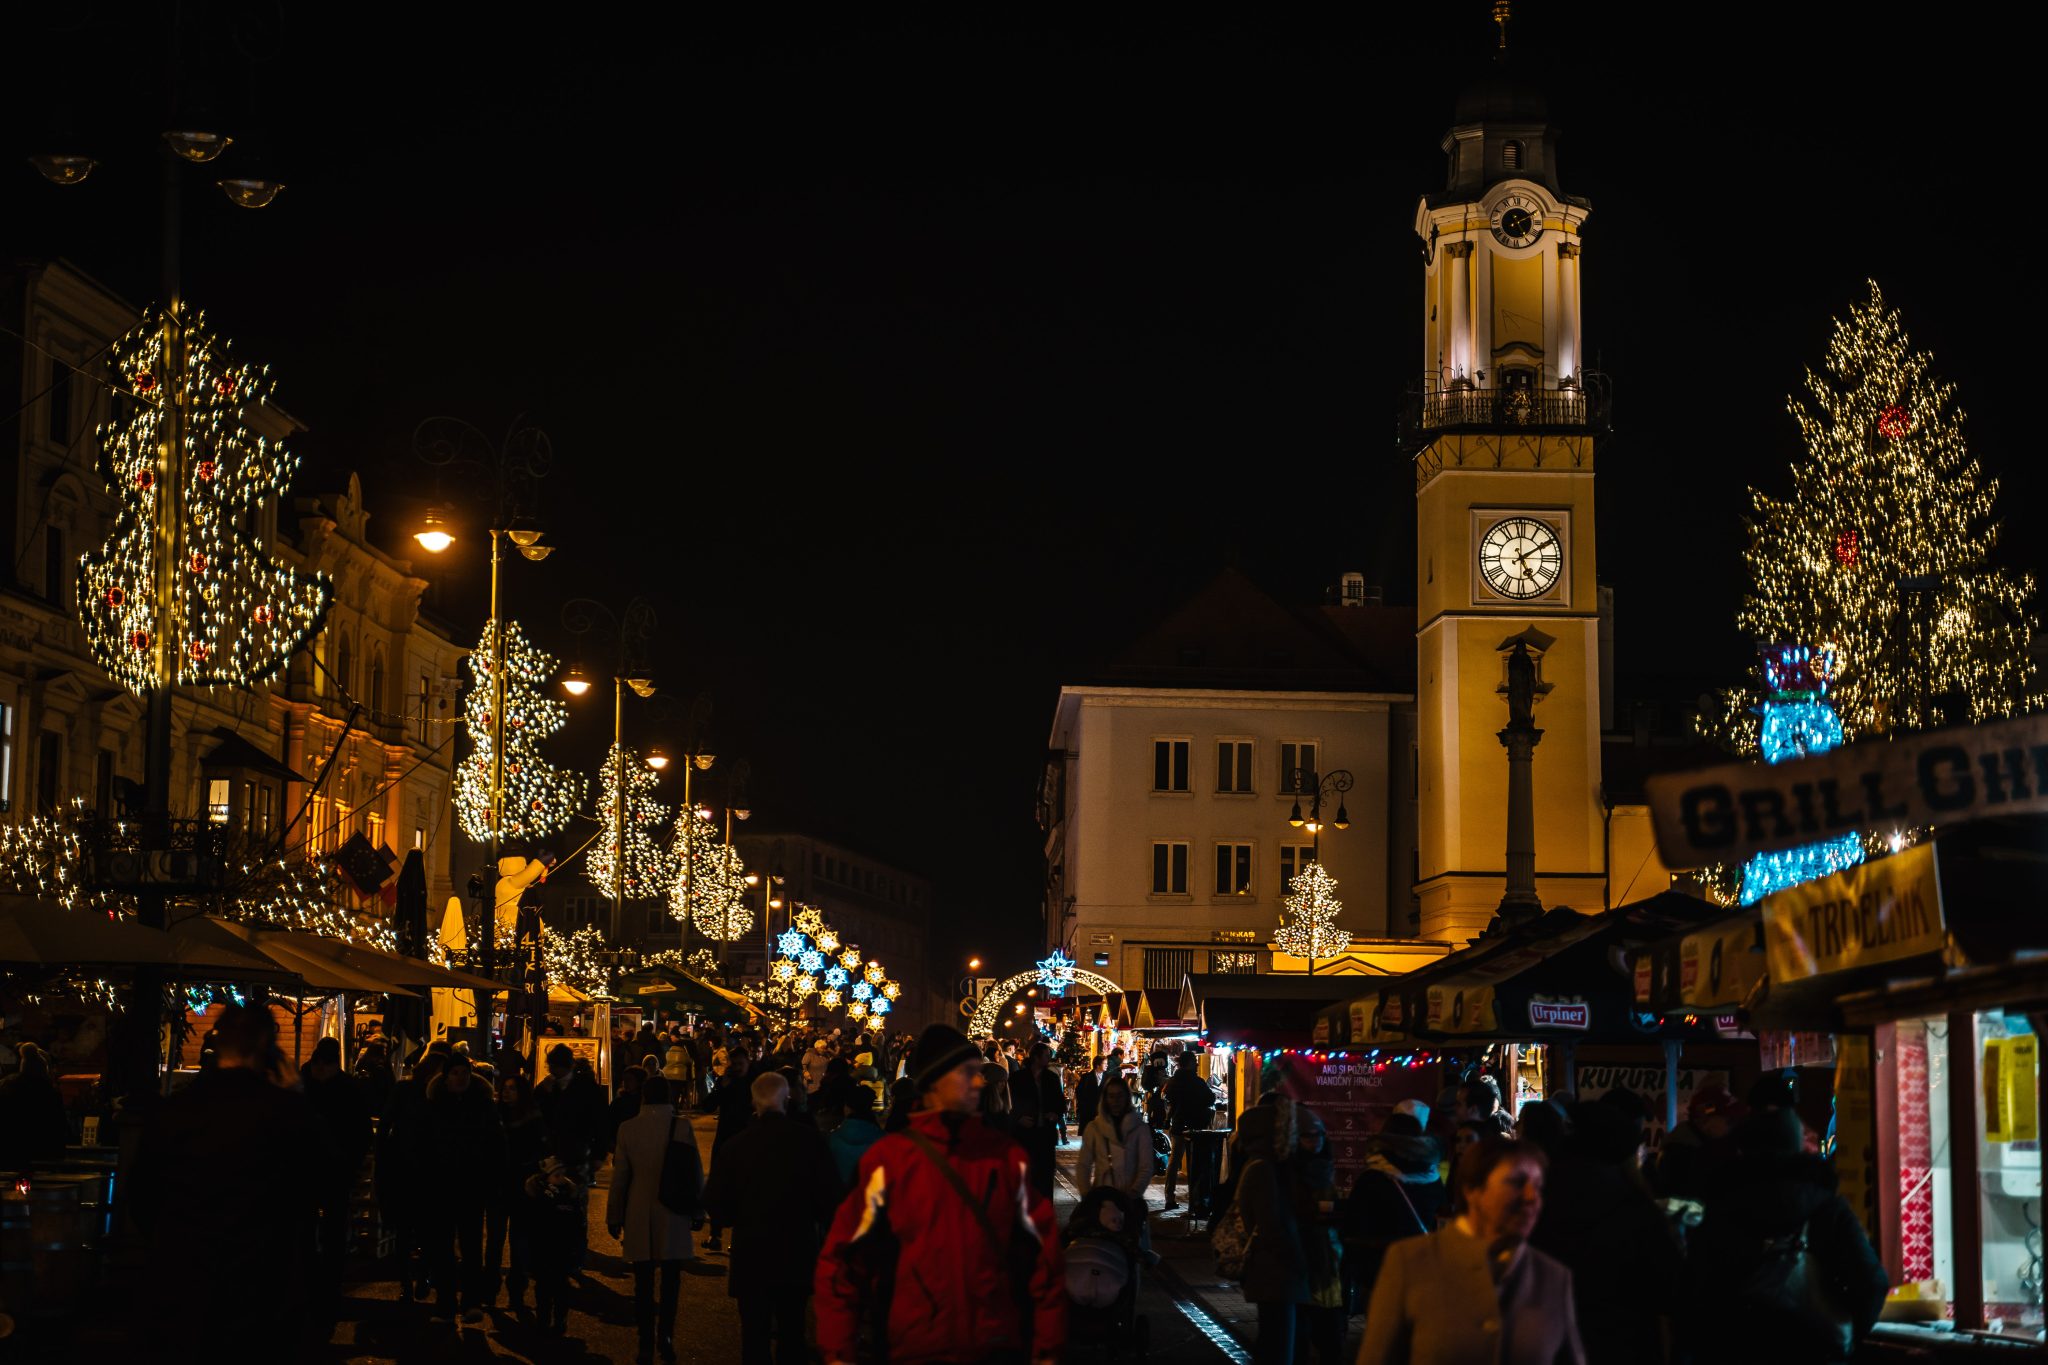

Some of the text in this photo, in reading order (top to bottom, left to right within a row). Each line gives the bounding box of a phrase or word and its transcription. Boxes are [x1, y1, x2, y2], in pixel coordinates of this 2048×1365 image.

[1682, 771, 1908, 849] GRILL
[1533, 1006, 1584, 1024] Urpiner
[1322, 1064, 1337, 1075] AKO
[1338, 1064, 1346, 1075] SI
[1580, 1068, 1694, 1090] KUKURIA
[1346, 1090, 1352, 1100] 1
[1345, 1119, 1353, 1130] 2
[1345, 1146, 1353, 1157] 3
